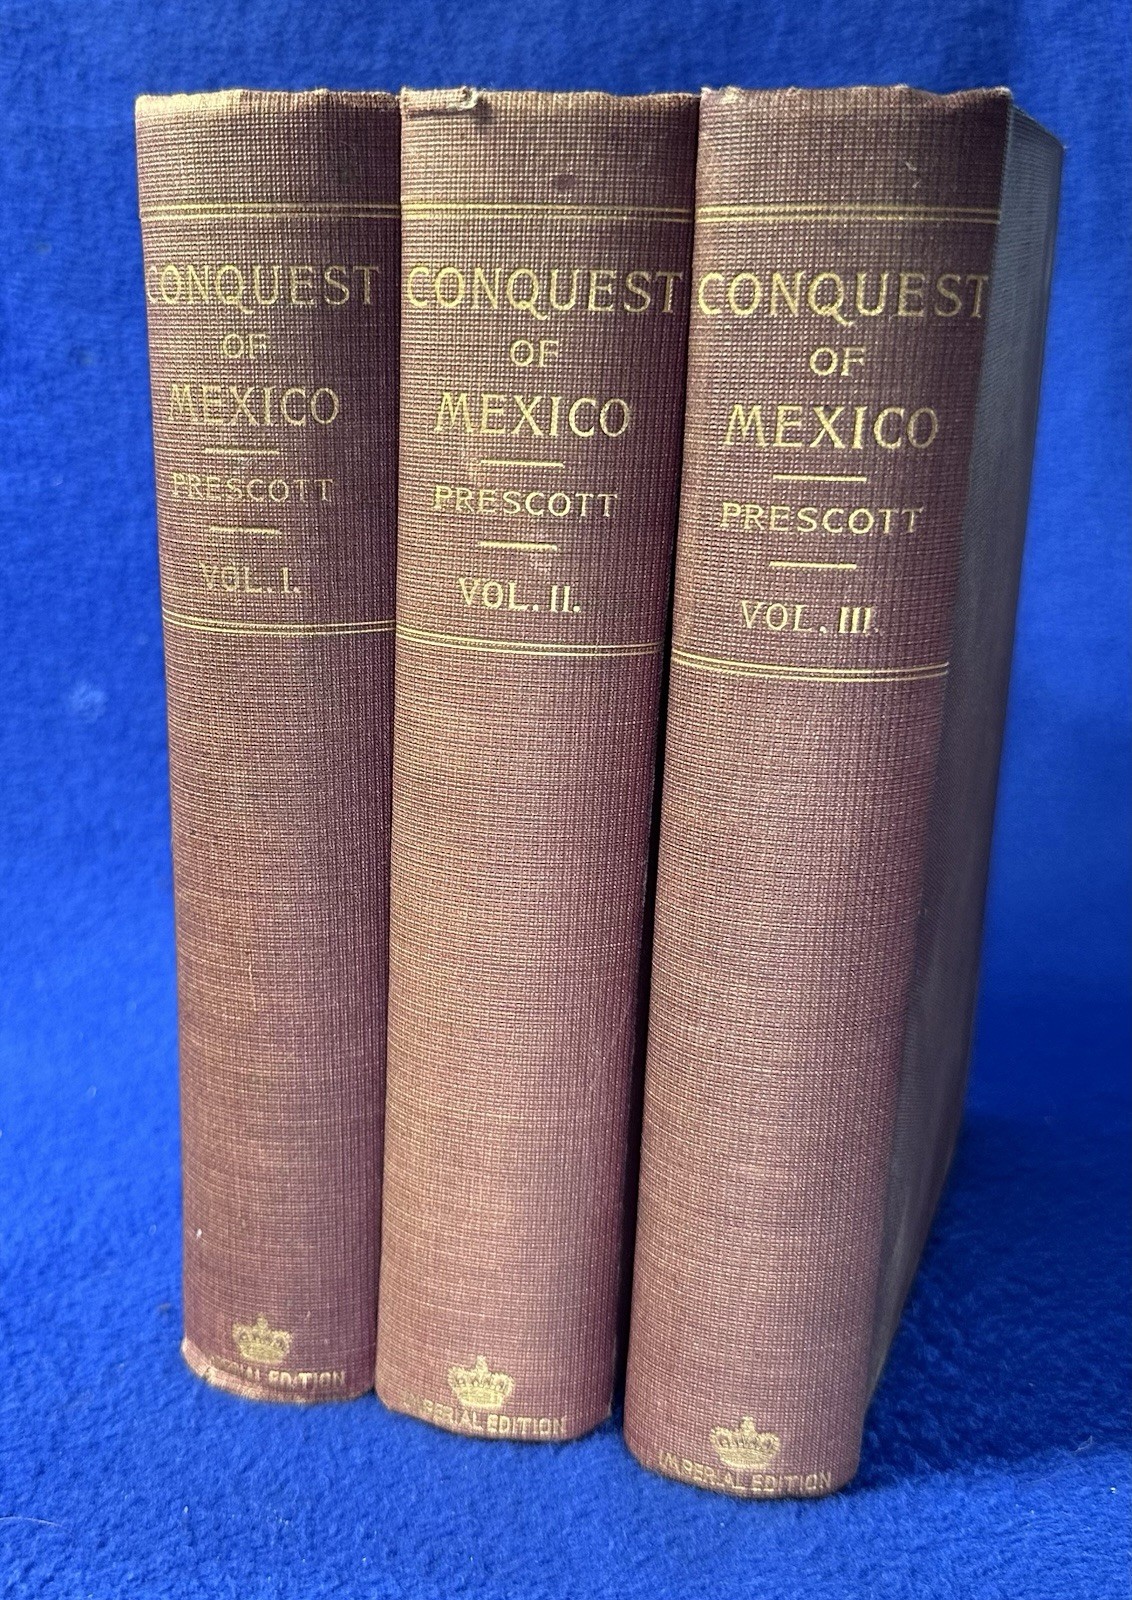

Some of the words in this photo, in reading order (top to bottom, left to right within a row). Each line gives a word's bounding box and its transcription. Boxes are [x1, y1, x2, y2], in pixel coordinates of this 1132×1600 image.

[146, 265, 379, 314] CONQUEST
[406, 266, 683, 320] CONQUEST
[698, 271, 989, 326] CONQUEST
[222, 333, 269, 359] OF
[509, 340, 559, 367] OF
[809, 346, 866, 376] OF
[168, 384, 340, 426] MEXICO
[433, 391, 631, 437] MEXICO
[723, 404, 939, 449] MEXICO
[172, 472, 333, 502] PRESCOTT
[434, 484, 617, 518] PRESCOTT
[720, 502, 923, 535] PRESCOTT
[199, 562, 274, 594] VOL.
[459, 577, 539, 613] VOL.
[550, 584, 581, 613] II.
[741, 600, 827, 634] VOL.
[268, 1369, 346, 1390] EDITION
[487, 1413, 566, 1436] EDITION
[750, 1471, 832, 1493] EDITION
